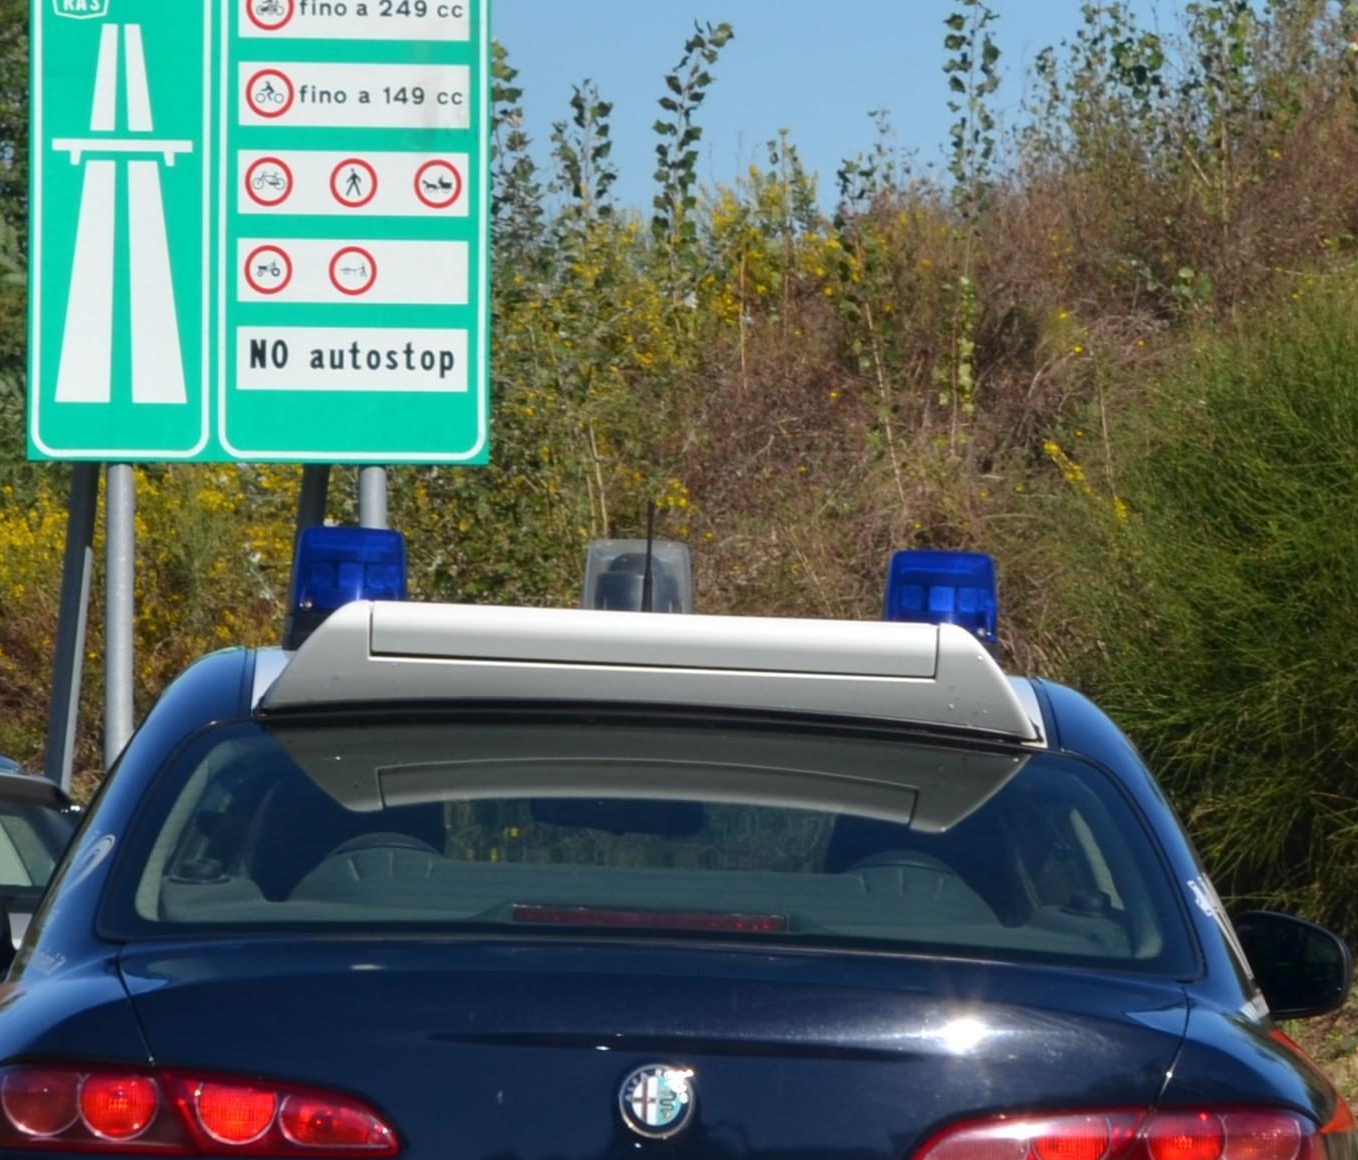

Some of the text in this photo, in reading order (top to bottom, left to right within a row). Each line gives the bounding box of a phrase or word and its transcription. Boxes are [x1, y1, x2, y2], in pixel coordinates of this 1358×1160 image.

[299, 0, 464, 18] fino a 249 cc
[299, 85, 464, 106] fino a 149 cc
[249, 338, 455, 379] NO autostop
